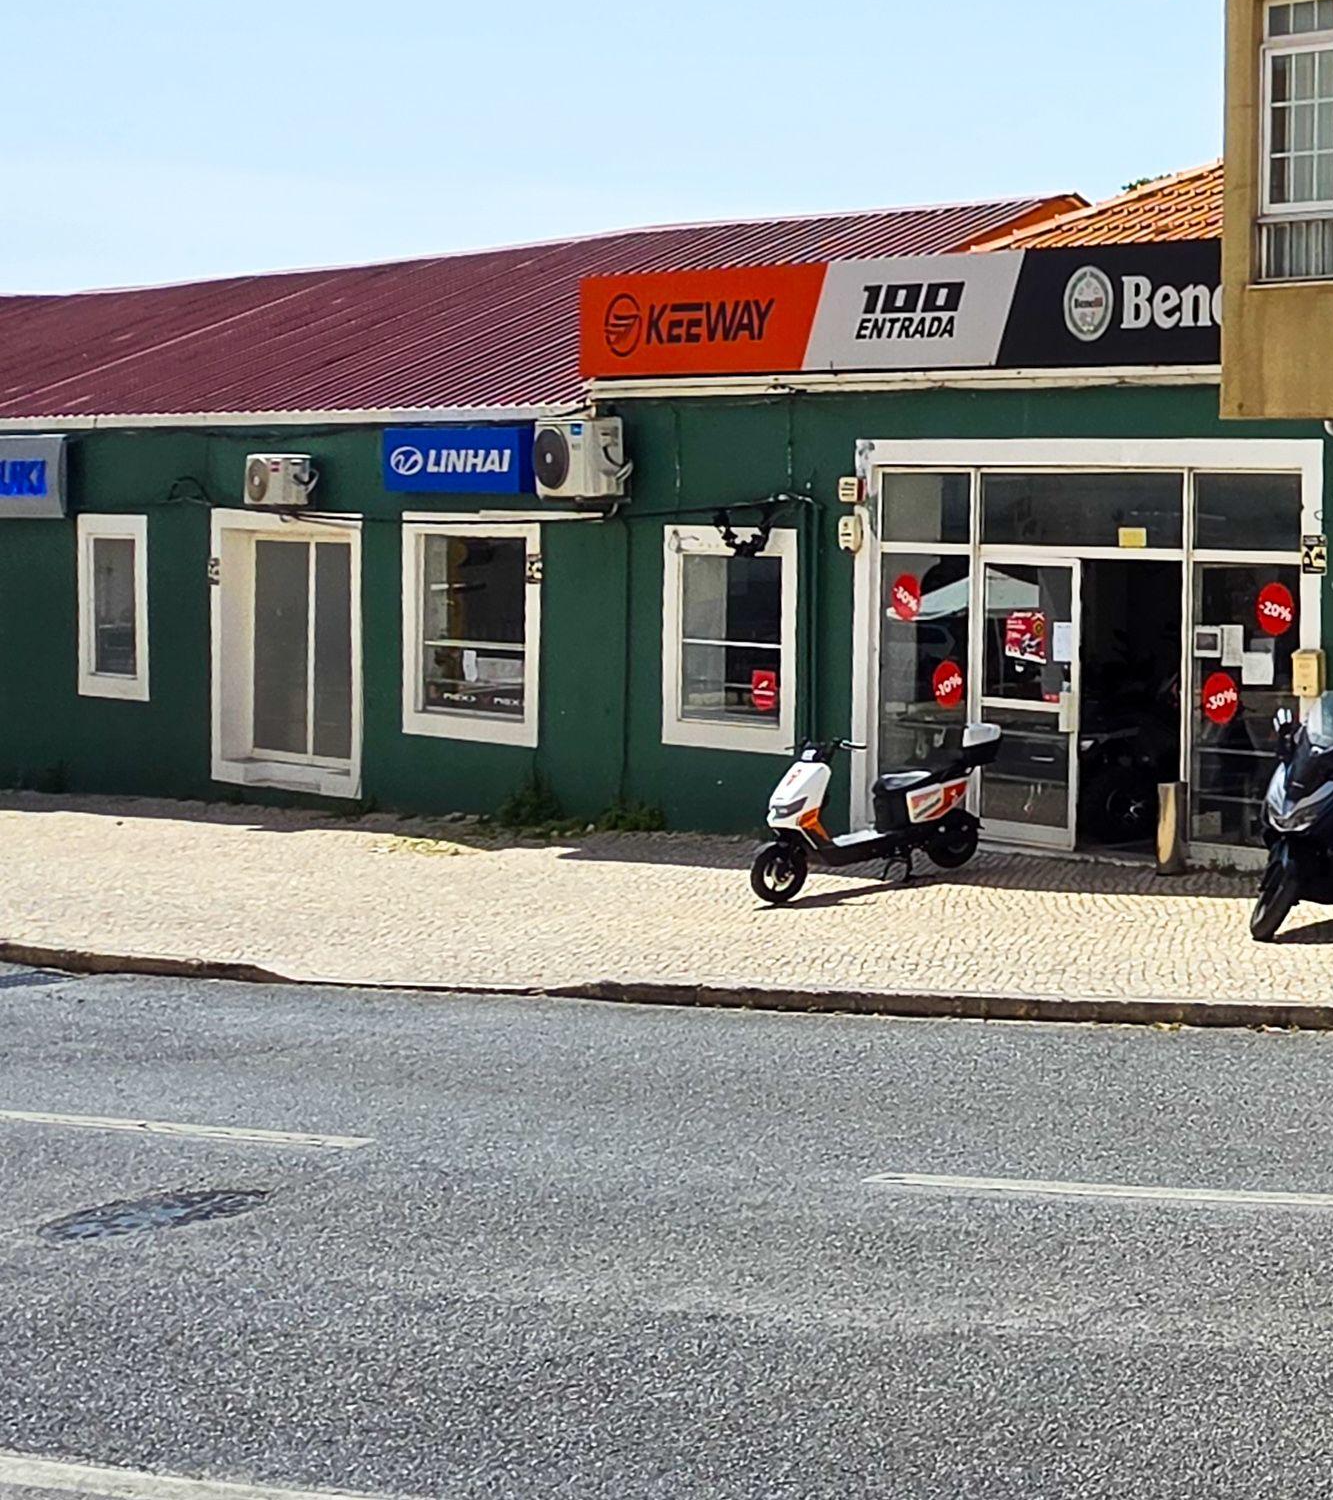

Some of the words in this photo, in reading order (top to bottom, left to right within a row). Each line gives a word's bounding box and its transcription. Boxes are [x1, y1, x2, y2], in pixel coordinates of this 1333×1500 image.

[863, 281, 965, 314] 100
[646, 298, 775, 345] KEEWAY
[855, 316, 955, 339] ENTRADA
[426, 449, 511, 473] LINHAI
[1259, 601, 1292, 622] -20%
[935, 672, 962, 696] -10%
